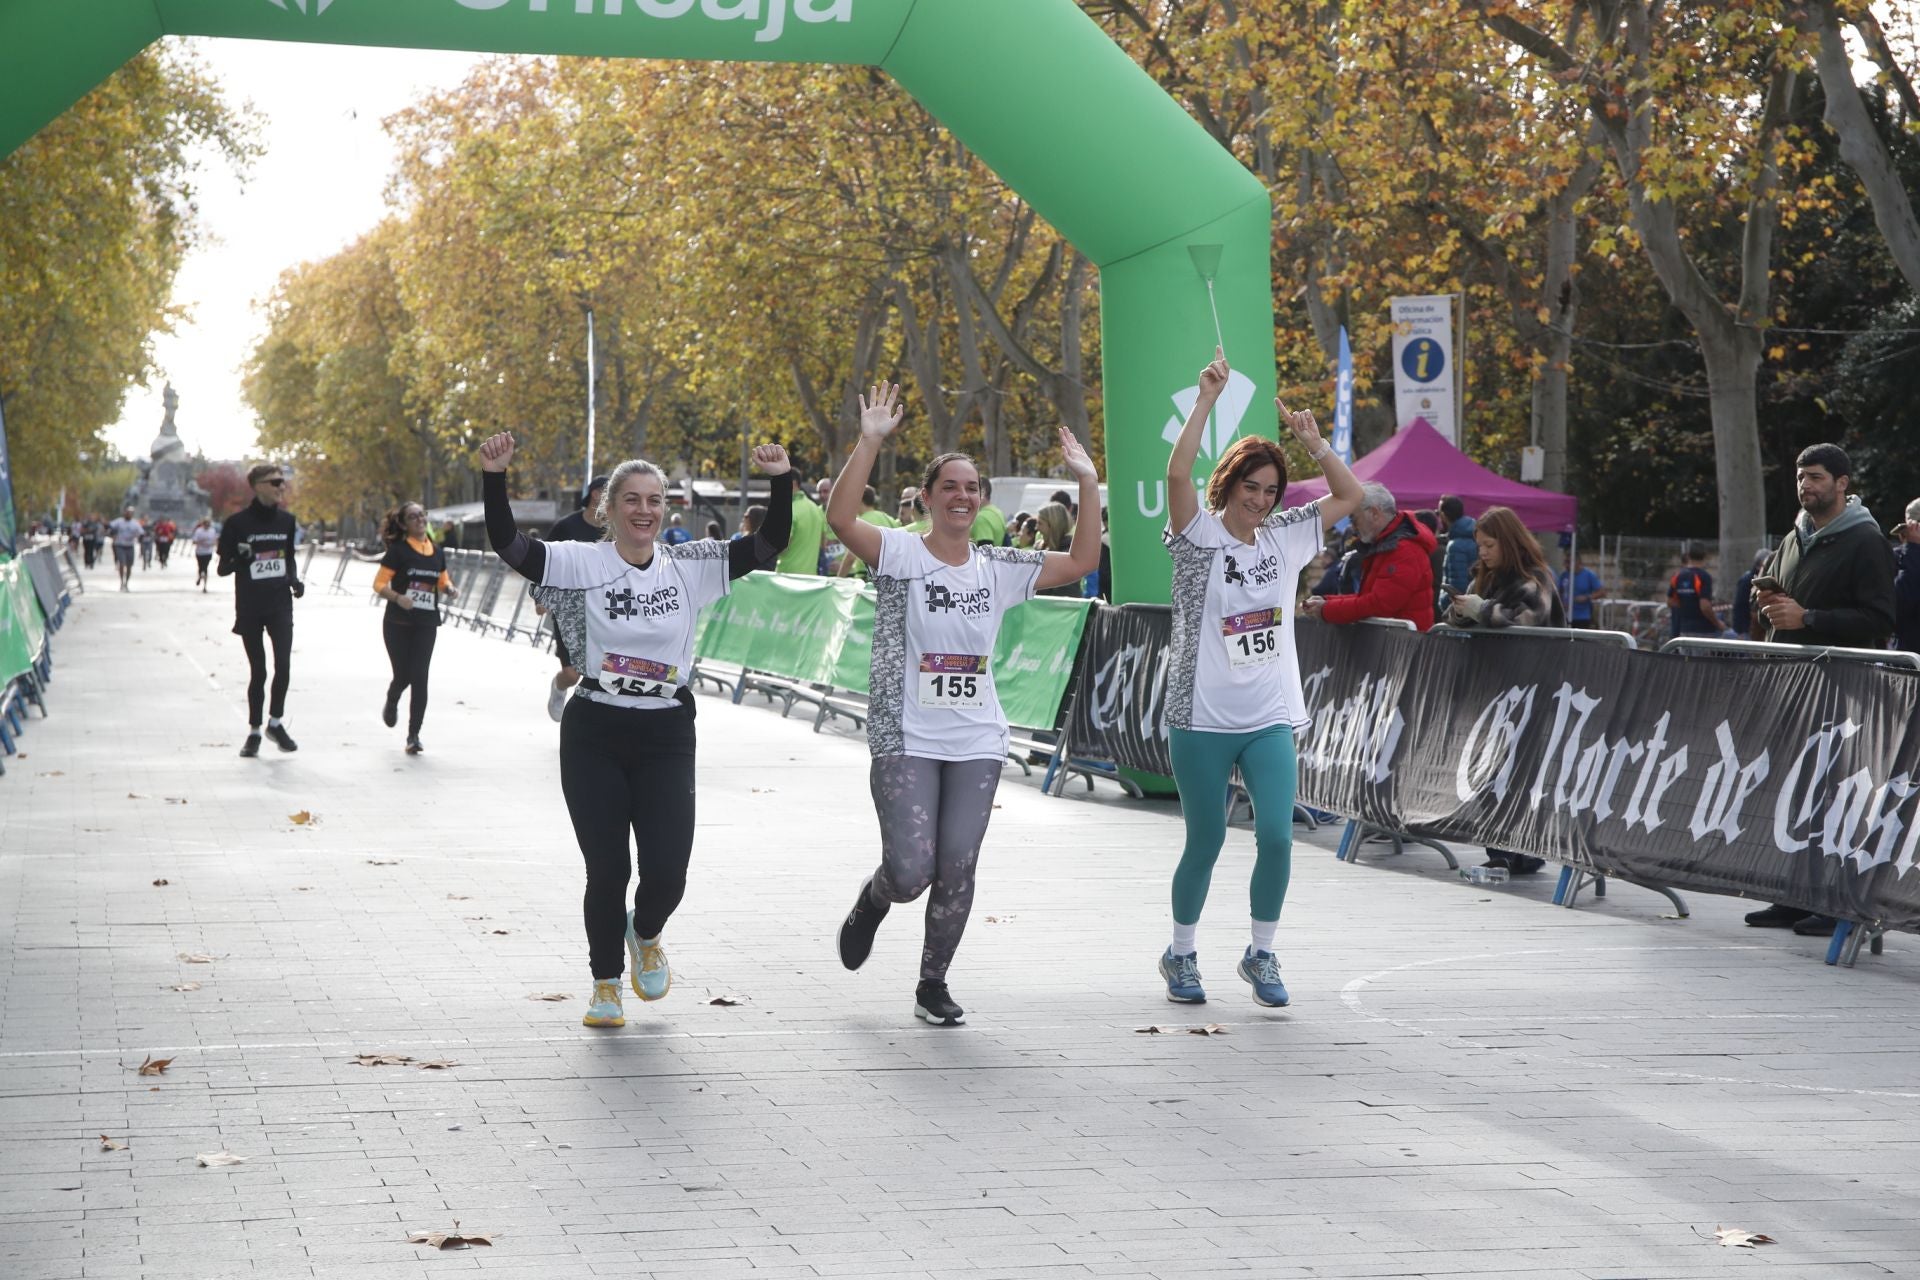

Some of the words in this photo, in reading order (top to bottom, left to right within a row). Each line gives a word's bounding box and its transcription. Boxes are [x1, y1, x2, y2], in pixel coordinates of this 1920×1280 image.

[255, 560, 281, 573] 246
[411, 591, 431, 603] 244
[643, 599, 680, 617] RAYAS
[1237, 630, 1275, 656] 156
[931, 675, 977, 698] 155
[1530, 681, 1689, 834] Norte
[1689, 719, 1771, 845] de
